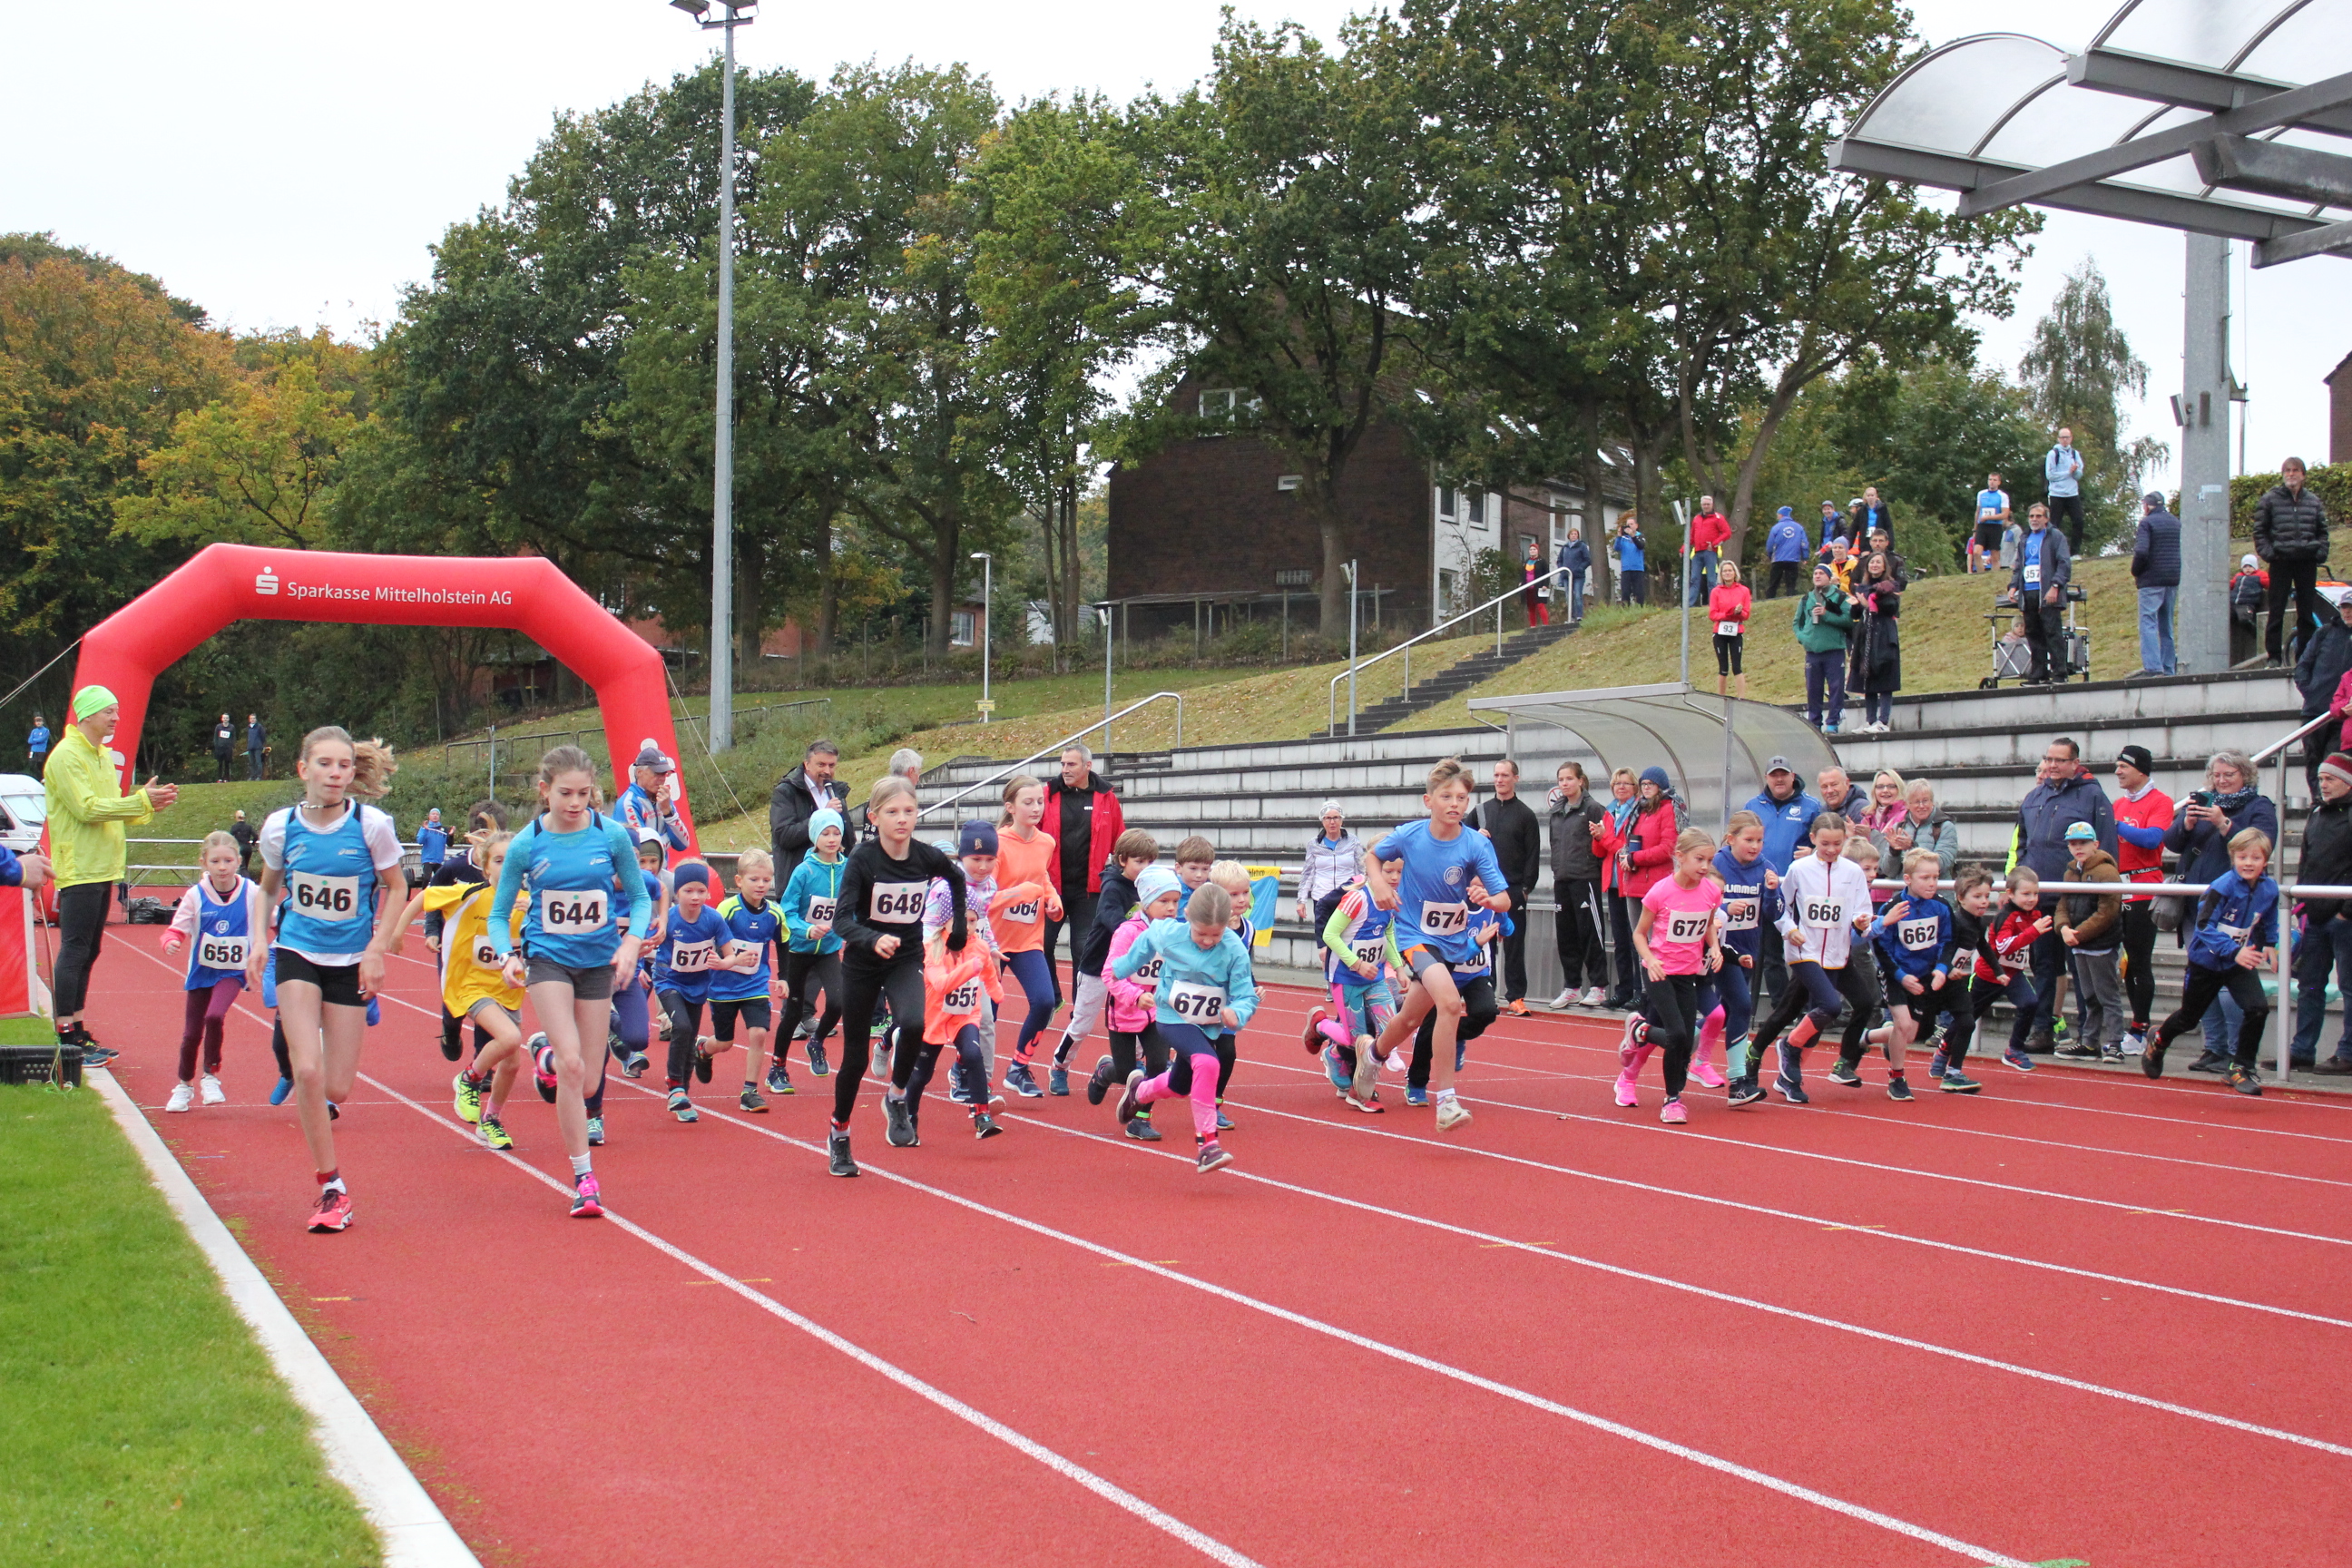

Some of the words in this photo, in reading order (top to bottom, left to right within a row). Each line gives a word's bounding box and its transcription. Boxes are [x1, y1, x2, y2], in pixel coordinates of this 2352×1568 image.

[287, 582, 370, 601] Sparkasse
[375, 586, 486, 604] Mittelholstein
[489, 590, 513, 605] AG
[1723, 624, 1734, 633] 93
[298, 884, 351, 911] 646
[1724, 883, 1760, 895] ummel
[549, 901, 600, 925] 644
[812, 905, 835, 921] 65
[877, 892, 923, 915] 648
[1808, 903, 1841, 922] 668
[1426, 909, 1465, 929] 674
[1673, 919, 1707, 936] 672
[1904, 925, 1936, 945] 662
[204, 944, 243, 963] 658
[676, 946, 713, 966] 677
[1357, 945, 1383, 963] 681
[1137, 960, 1163, 978] 68
[945, 986, 978, 1007] 655
[1174, 992, 1221, 1016] 678
